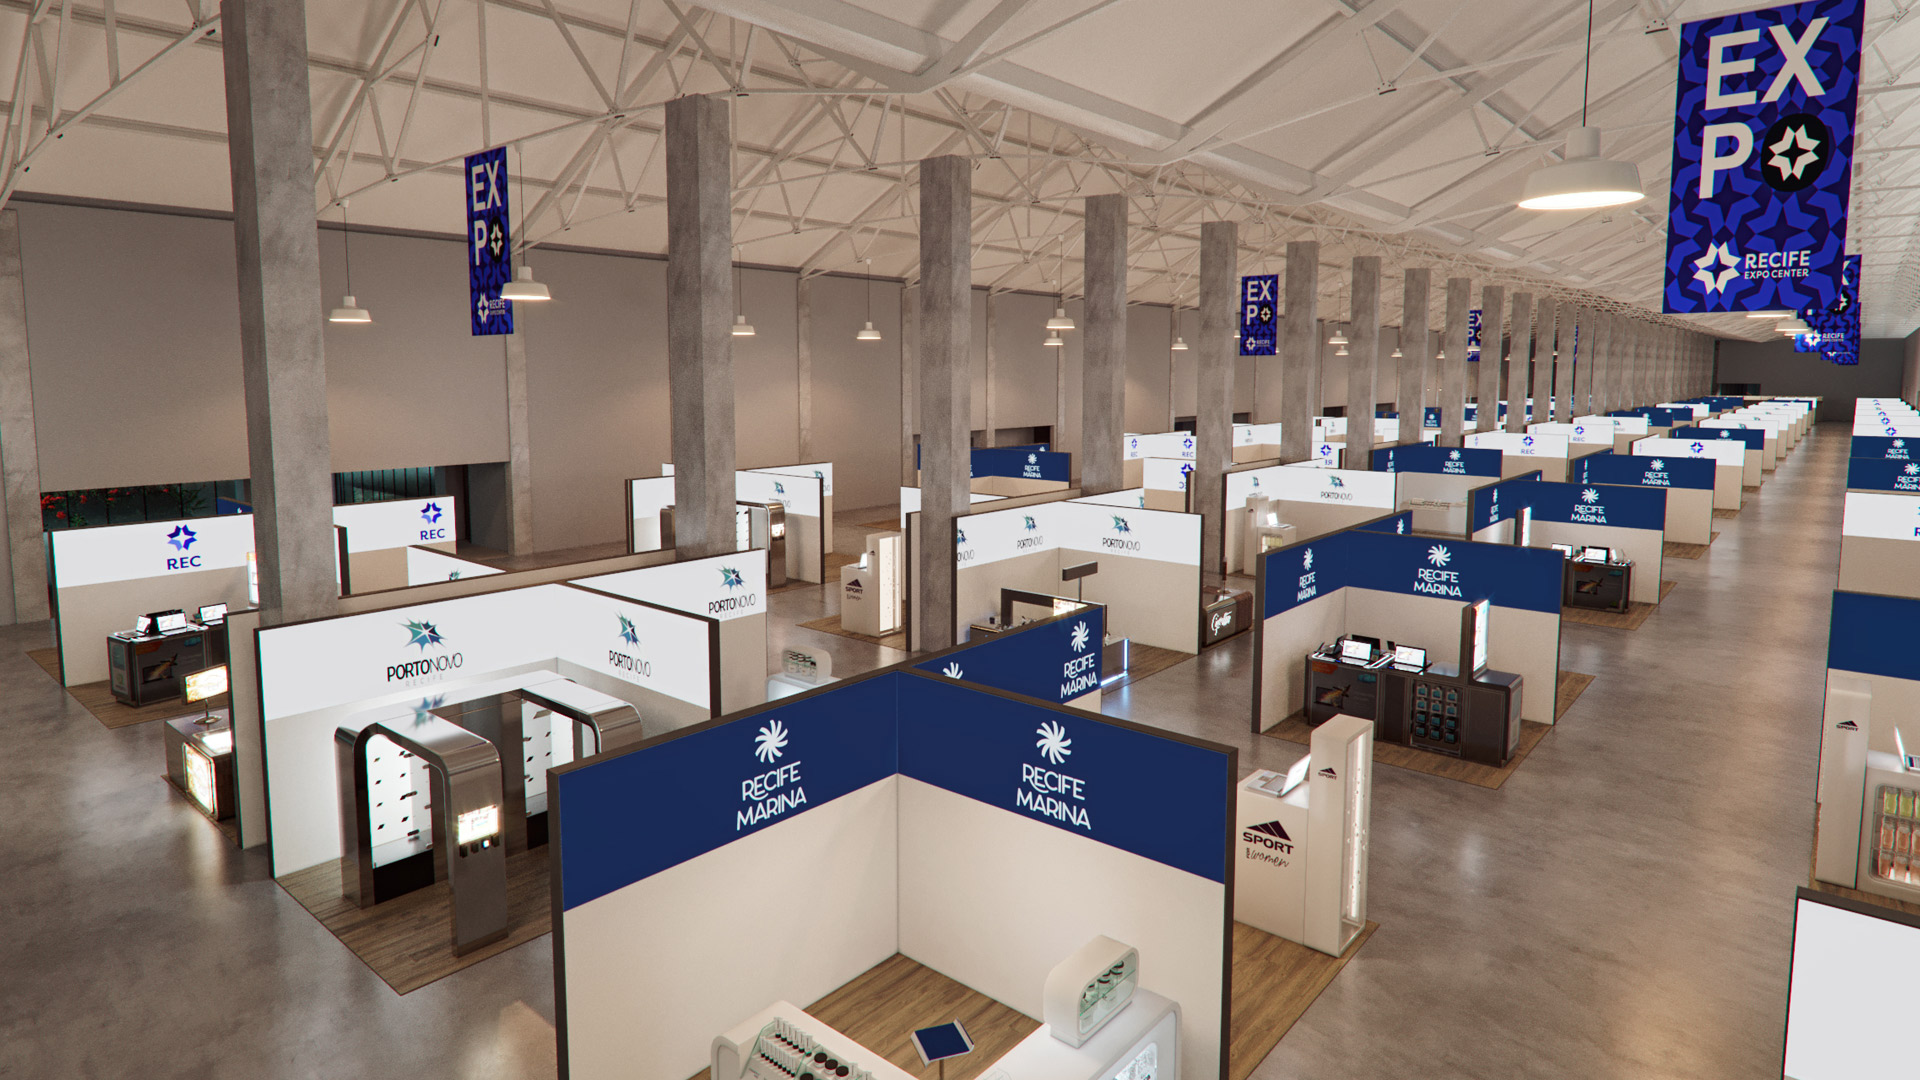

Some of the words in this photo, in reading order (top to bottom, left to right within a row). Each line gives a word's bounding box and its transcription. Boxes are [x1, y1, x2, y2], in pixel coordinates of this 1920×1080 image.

[1705, 17, 1830, 110] EX
[472, 160, 502, 212] EX
[1745, 250, 1811, 269] RECIFE
[1744, 270, 1770, 279] EXPO
[1771, 268, 1809, 278] CENTER
[1247, 280, 1272, 301] EX
[489, 300, 505, 309] RECIFE
[1641, 478, 1671, 486] MARINA
[1644, 471, 1669, 480] RECIFE
[1570, 513, 1607, 524] MARINA
[1574, 504, 1605, 515] RECIFE
[420, 528, 446, 541] REC
[1102, 537, 1141, 552] PORTONOVO
[166, 555, 202, 570] REC
[1299, 571, 1316, 588] RECIFE
[1418, 568, 1459, 583] RECIFE
[1297, 585, 1317, 602] MARINA
[1413, 581, 1463, 598] MARINA
[708, 593, 756, 615] PORTONOVO
[386, 652, 463, 682] PORTONOVO
[609, 649, 651, 678] PORTONOVO
[1063, 652, 1095, 679] RECIFE
[1060, 671, 1098, 699] MARINA
[742, 760, 802, 802] RECIFE
[1022, 762, 1086, 801] RECIFE
[736, 786, 807, 831] MARINA
[1016, 787, 1092, 831] MARINA
[1242, 831, 1294, 855] SPORT
